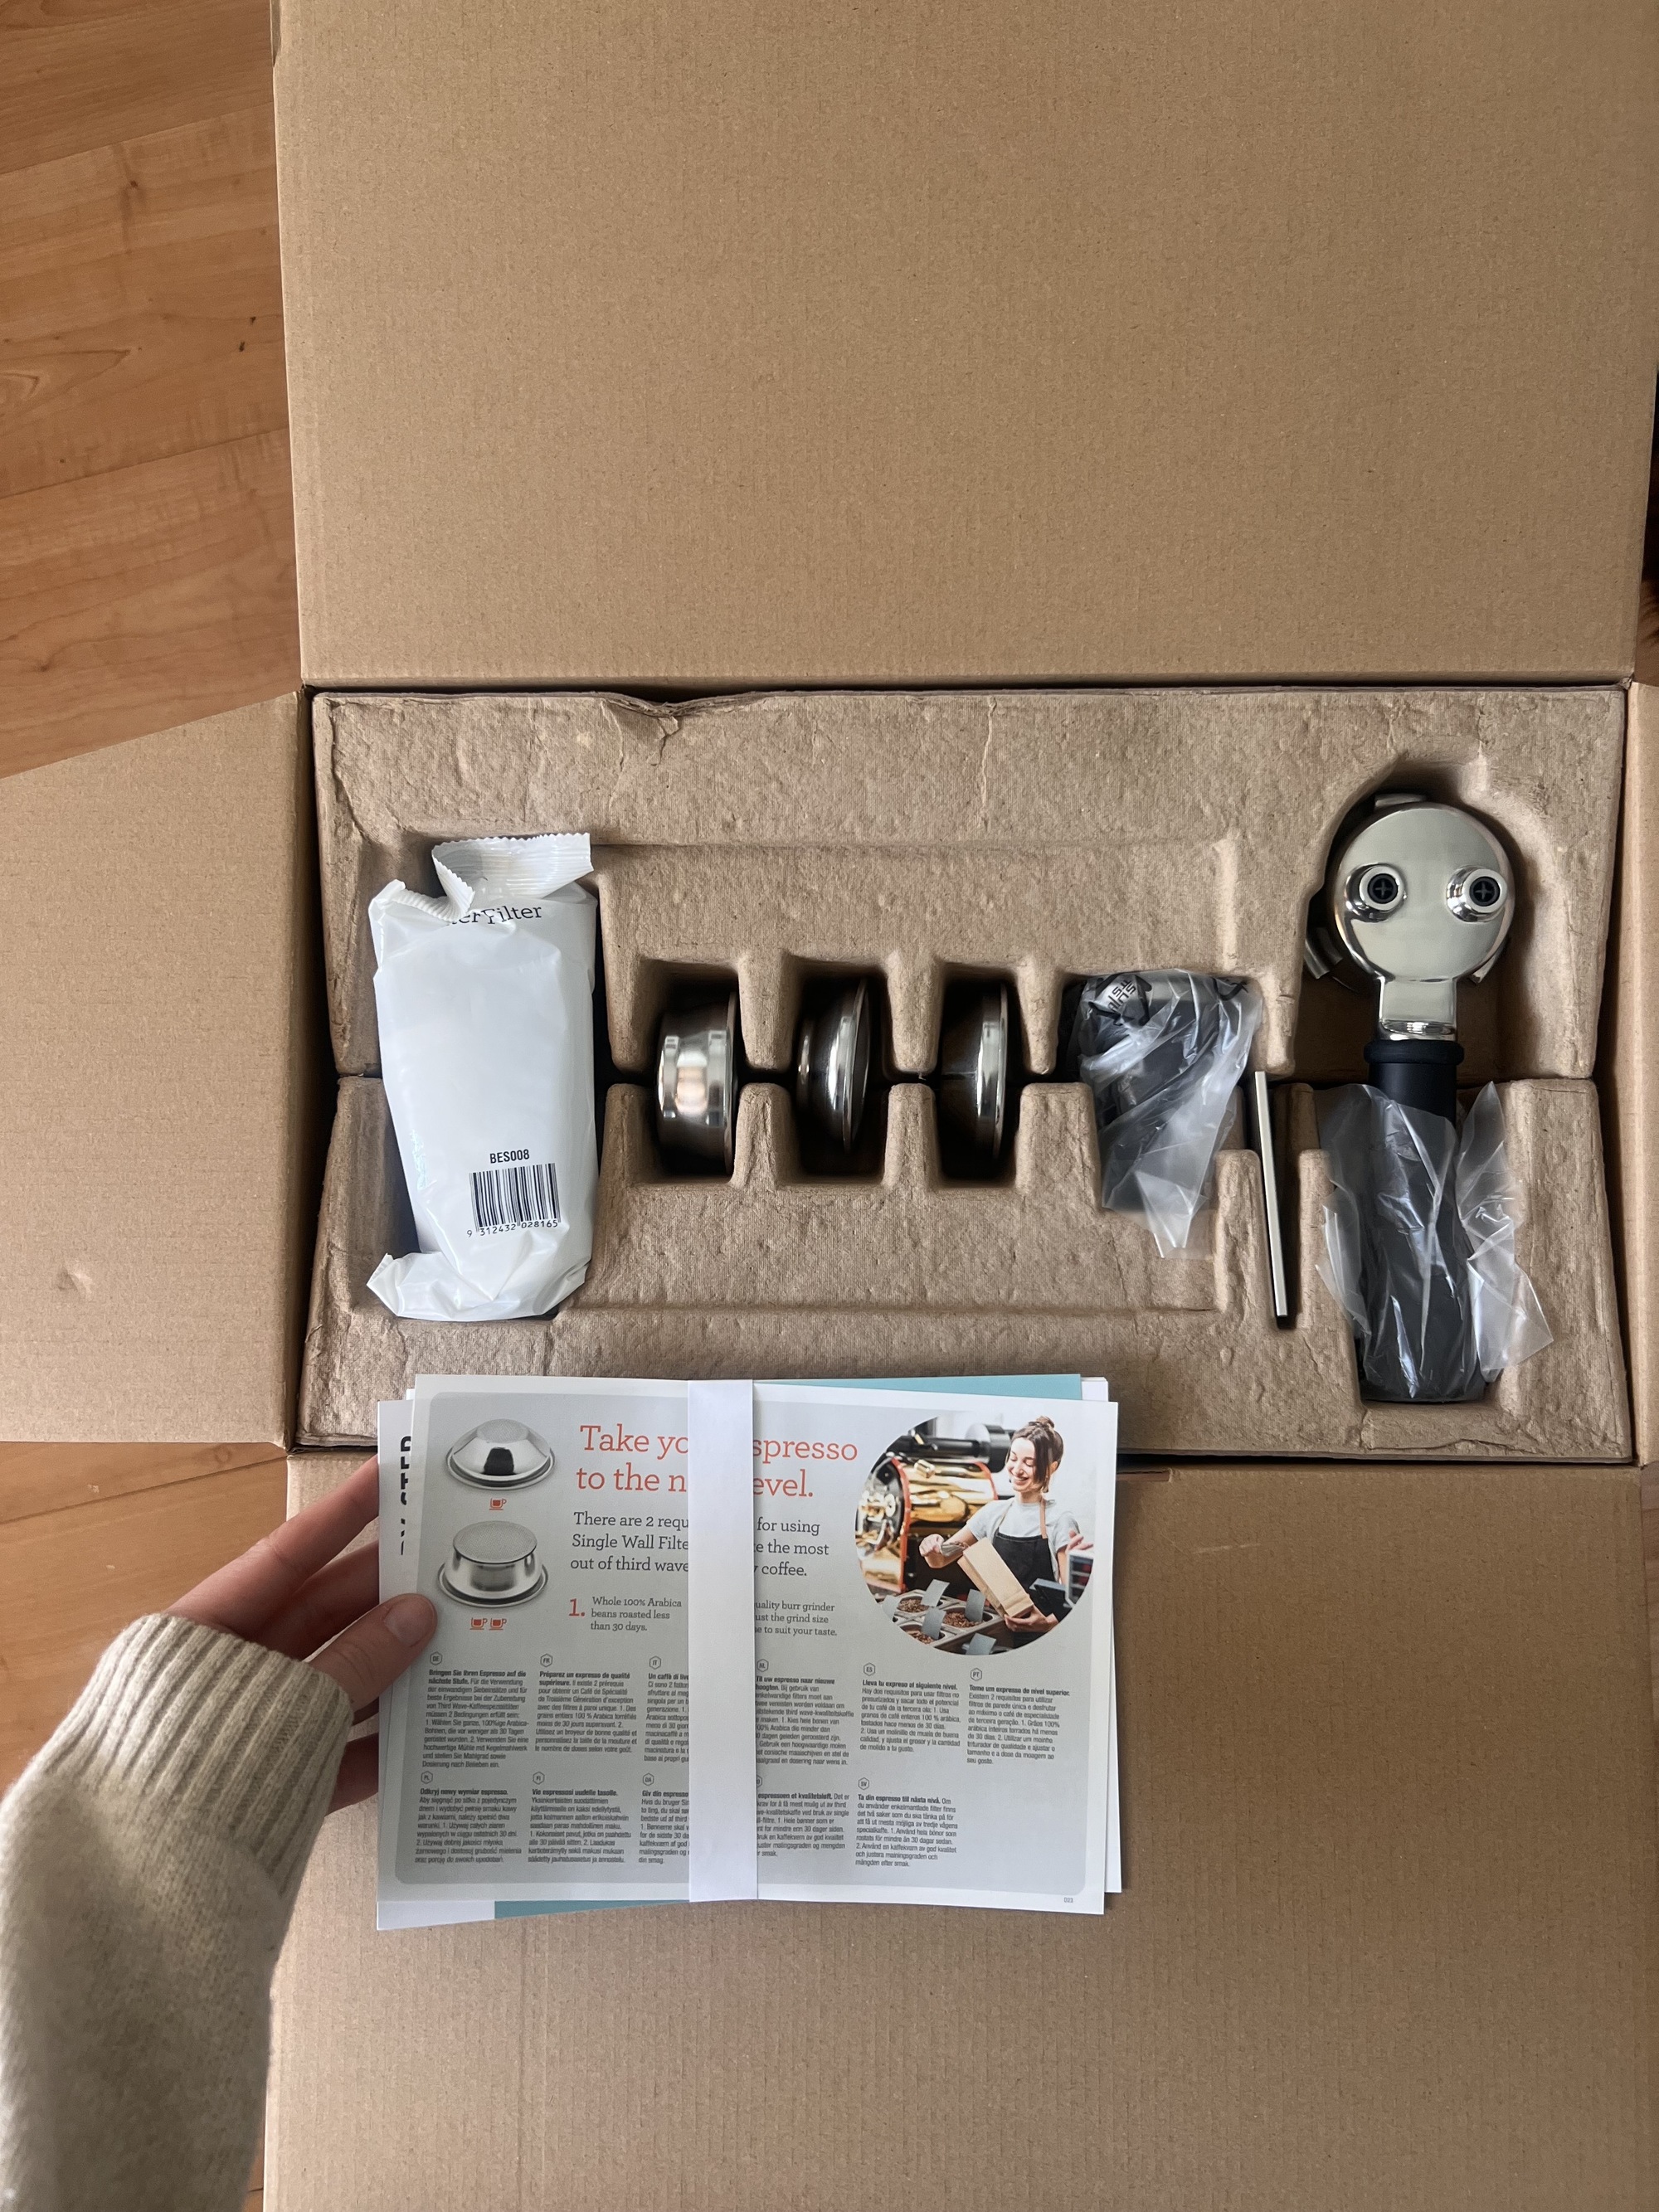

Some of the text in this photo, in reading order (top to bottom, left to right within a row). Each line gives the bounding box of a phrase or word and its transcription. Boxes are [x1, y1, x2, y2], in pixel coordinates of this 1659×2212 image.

[489, 1150, 529, 1164] BES008
[479, 1224, 516, 1236] 312432
[521, 1220, 557, 1228] 028165
[580, 1423, 858, 1464] Take yo spresso
[576, 1467, 605, 1490] to
[614, 1462, 659, 1490] the
[753, 1469, 814, 1497] evel.
[573, 1510, 615, 1525] There
[619, 1517, 642, 1526] are
[645, 1516, 654, 1527] 2
[757, 1517, 777, 1532] for
[781, 1519, 820, 1536] using
[572, 1533, 617, 1551] Single
[621, 1534, 654, 1548] Wall
[658, 1534, 688, 1549] Filte
[767, 1539, 790, 1553] the
[793, 1544, 829, 1555] most
[570, 1558, 594, 1569] out
[597, 1555, 613, 1569] of
[615, 1555, 650, 1570] third
[654, 1562, 688, 1572] wave
[761, 1561, 806, 1576] coffee.
[568, 1598, 586, 1617] 1.
[591, 1596, 621, 1606] Whole
[647, 1597, 682, 1607] Arabica
[755, 1600, 835, 1613] uality burr grinder
[591, 1607, 669, 1619] beans roasted less
[755, 1612, 828, 1625] ust the grind size
[590, 1620, 647, 1632] than 30 days.
[774, 1626, 791, 1634] suit
[792, 1628, 812, 1636] your
